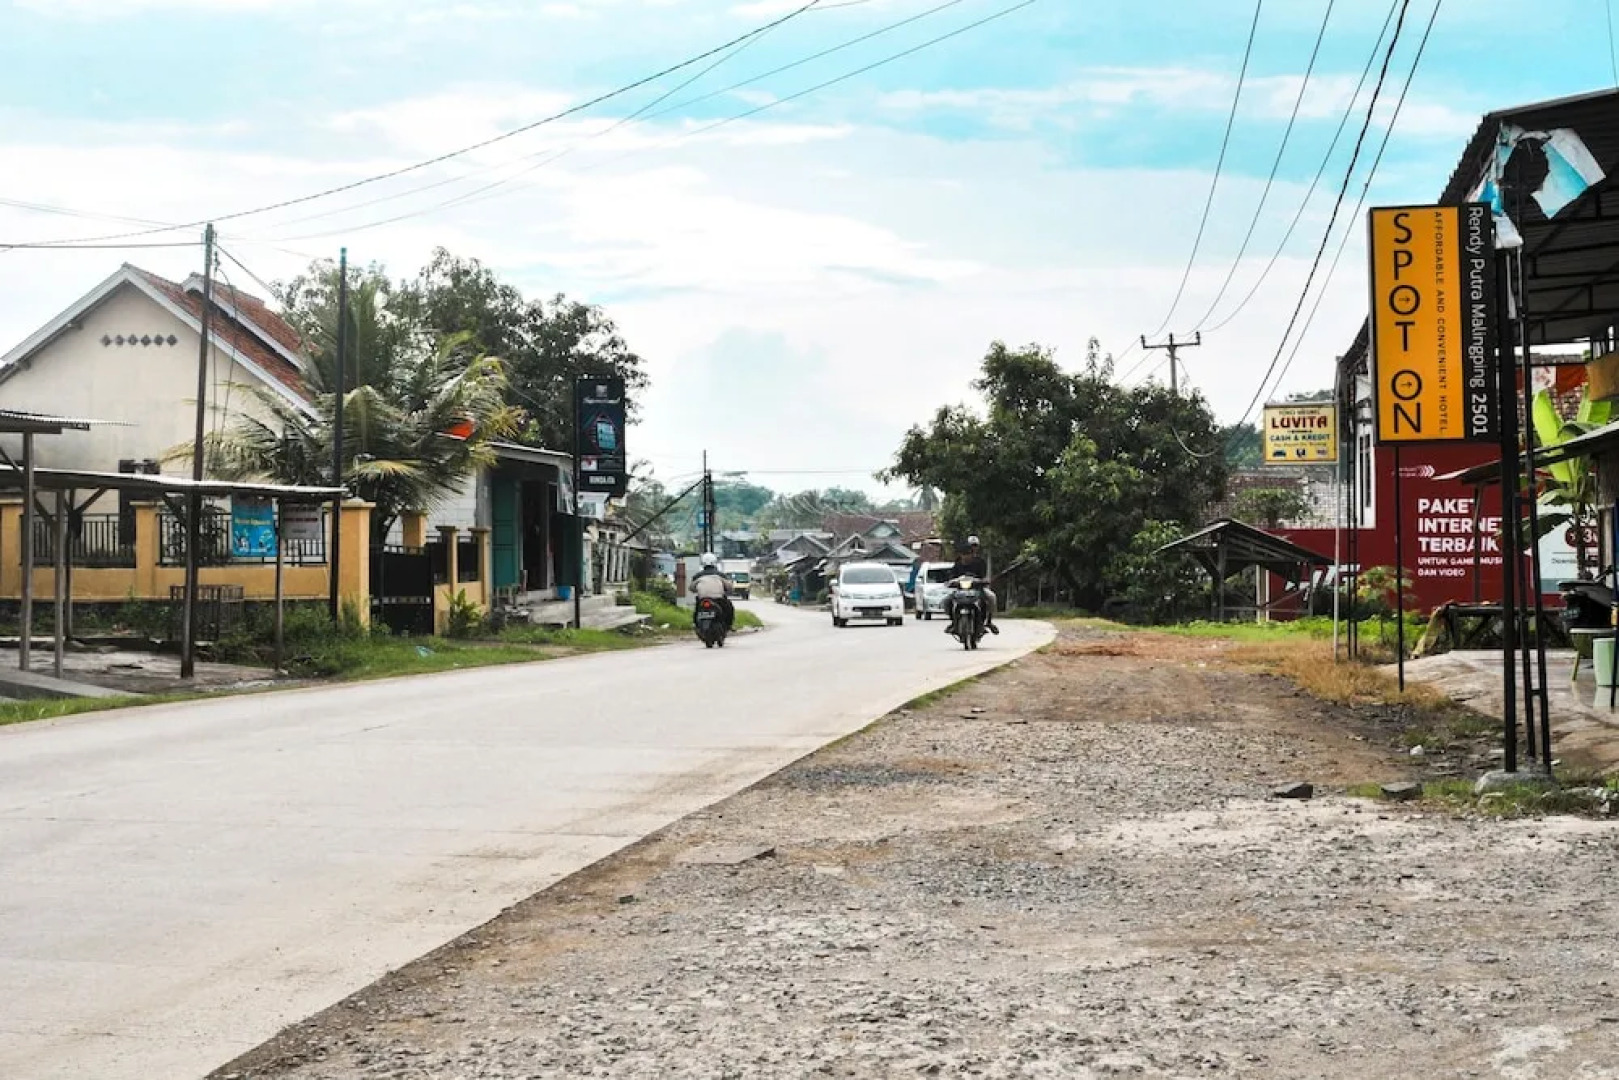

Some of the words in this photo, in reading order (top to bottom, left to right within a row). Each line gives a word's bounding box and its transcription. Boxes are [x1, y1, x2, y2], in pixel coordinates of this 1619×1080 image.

[1435, 211, 1444, 284] AFFORDABLE
[1465, 207, 1485, 254] Rendy
[1389, 212, 1421, 352] SPOT
[1469, 259, 1486, 300] Putra
[1437, 290, 1445, 313] AND
[1437, 318, 1447, 389] CONVENIENT
[1468, 303, 1488, 388] Malingping
[1271, 415, 1328, 429] LUVITA
[1391, 369, 1422, 435] ON
[1439, 395, 1448, 434] HOTEL
[1471, 393, 1489, 436] 2501
[1418, 556, 1448, 565] UNTUK
[1418, 568, 1437, 577] DAN
[1439, 568, 1466, 576] VIDEO
